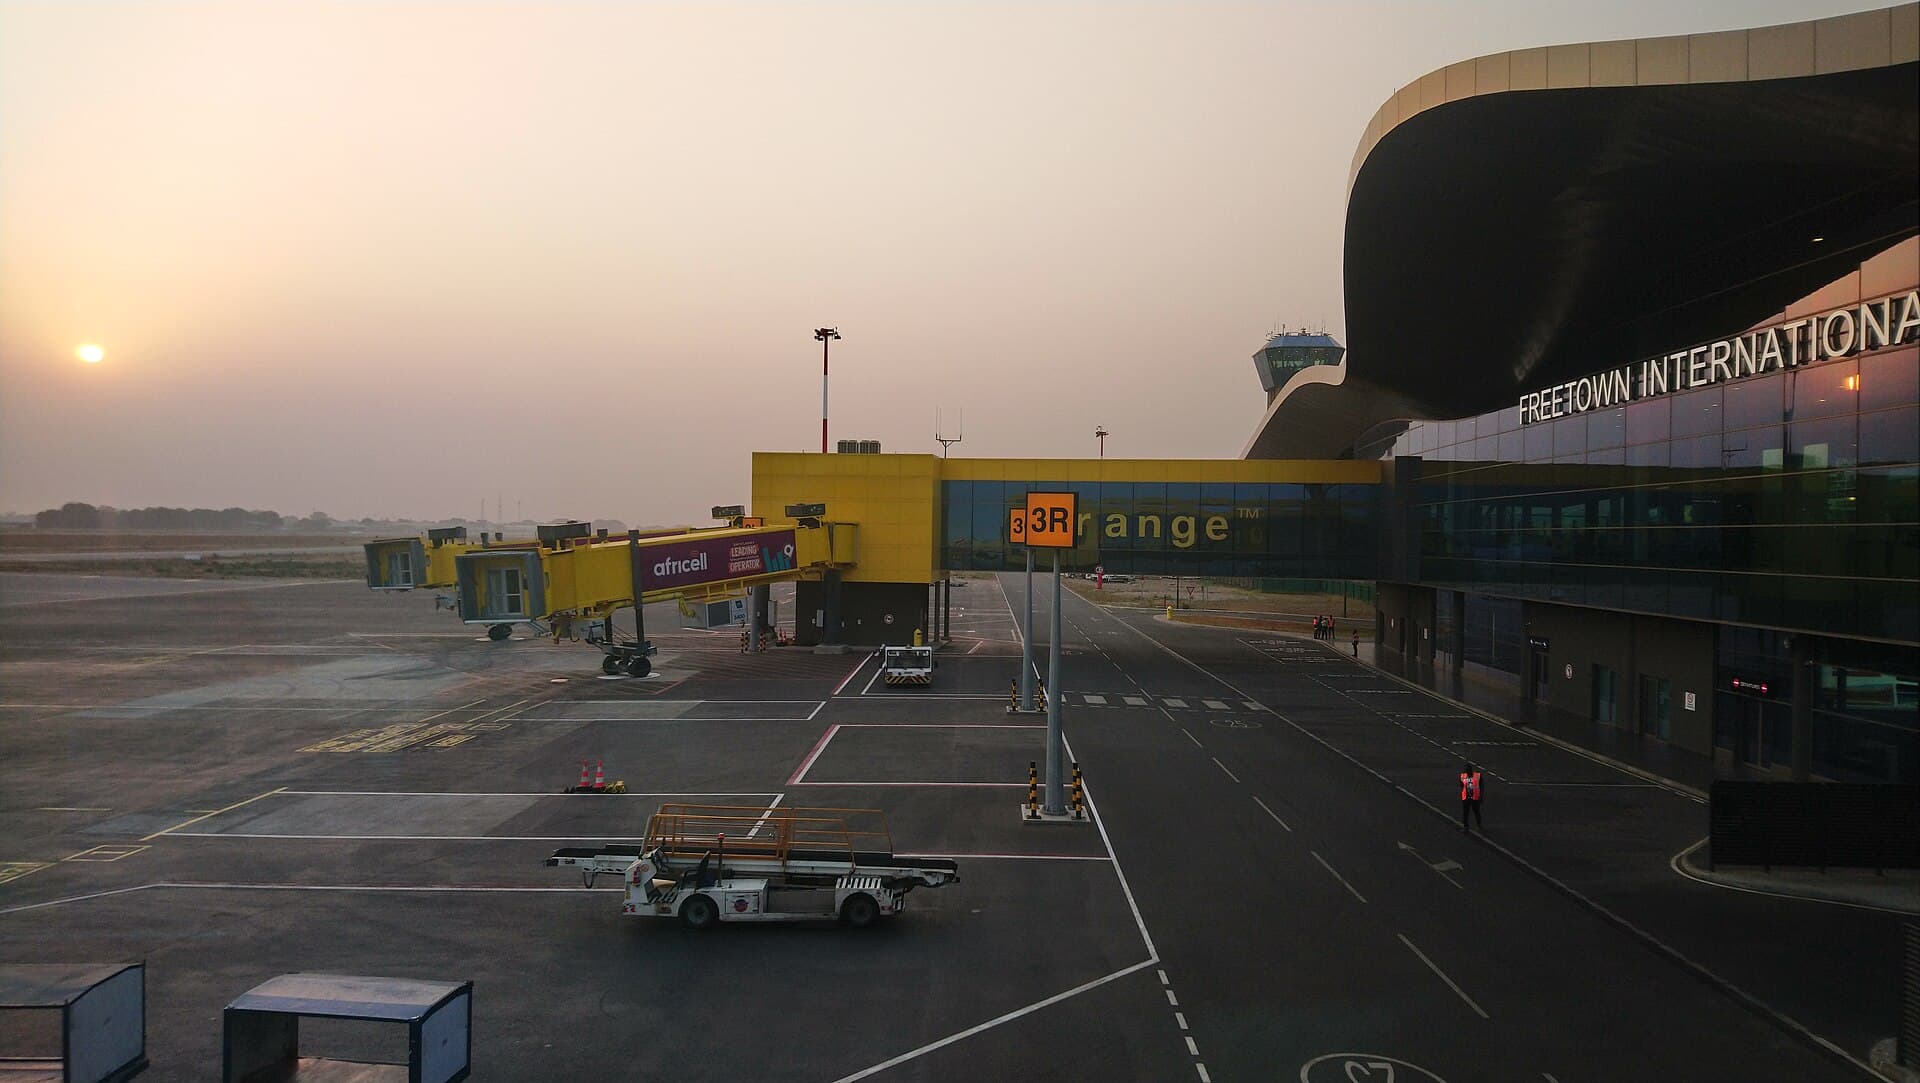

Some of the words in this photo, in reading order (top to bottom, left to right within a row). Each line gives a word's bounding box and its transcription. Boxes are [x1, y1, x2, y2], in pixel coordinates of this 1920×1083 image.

[1519, 366, 1631, 425] FREETOWN
[1642, 290, 1920, 398] INTERNATIONA
[1013, 517, 1026, 534] 3
[1031, 507, 1069, 533] 3R
[1077, 511, 1230, 548] range
[731, 545, 758, 557] LEADING
[653, 552, 709, 577] africell
[730, 559, 760, 572] OPERATOR
